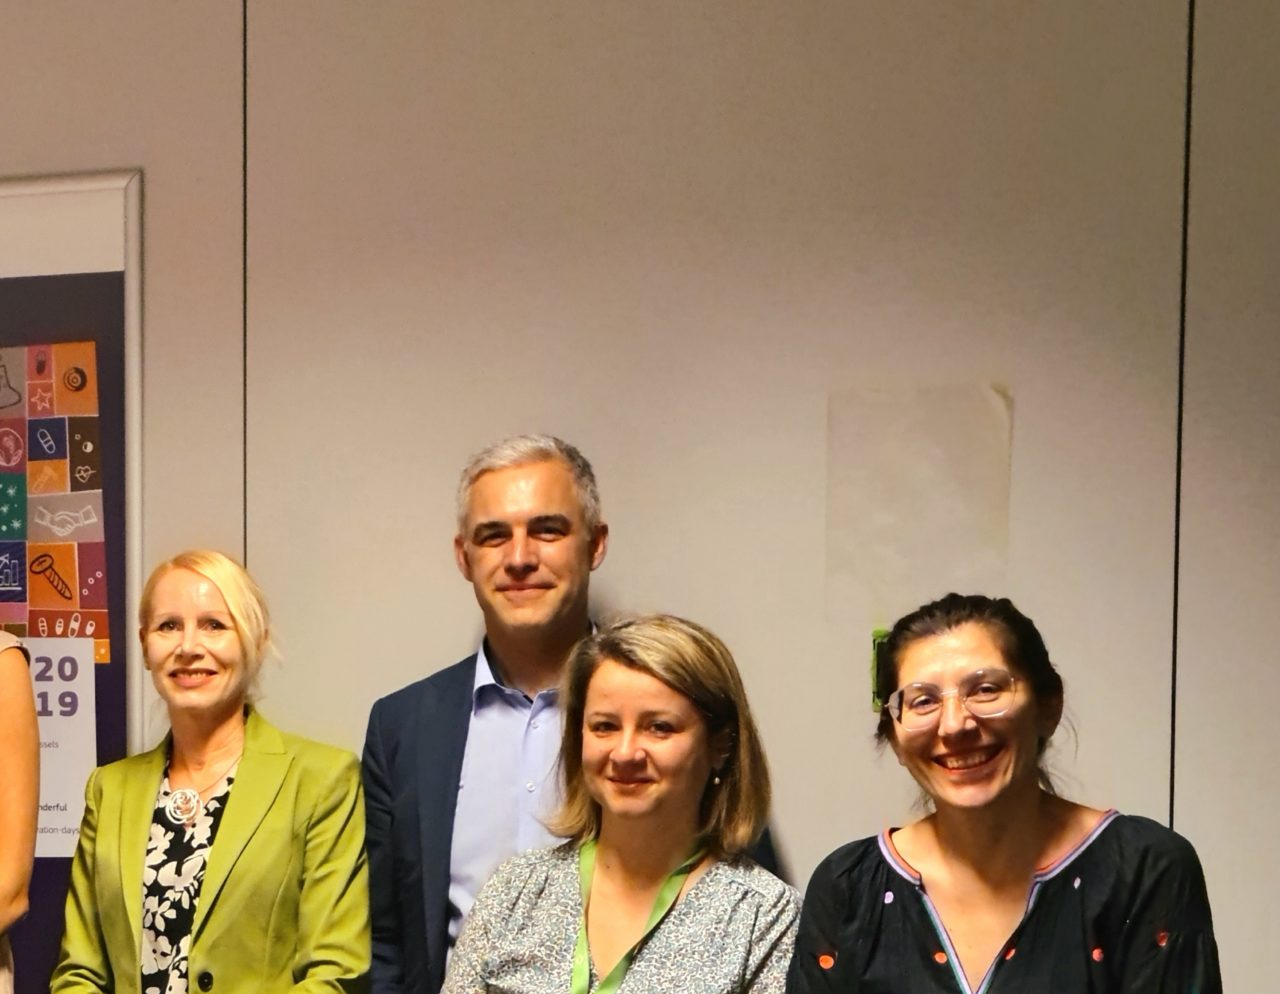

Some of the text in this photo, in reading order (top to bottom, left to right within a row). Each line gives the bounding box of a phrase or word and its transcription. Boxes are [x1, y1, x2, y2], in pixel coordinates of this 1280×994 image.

[34, 655, 79, 682] 20
[36, 691, 79, 717] 19
[38, 802, 68, 812] nderful
